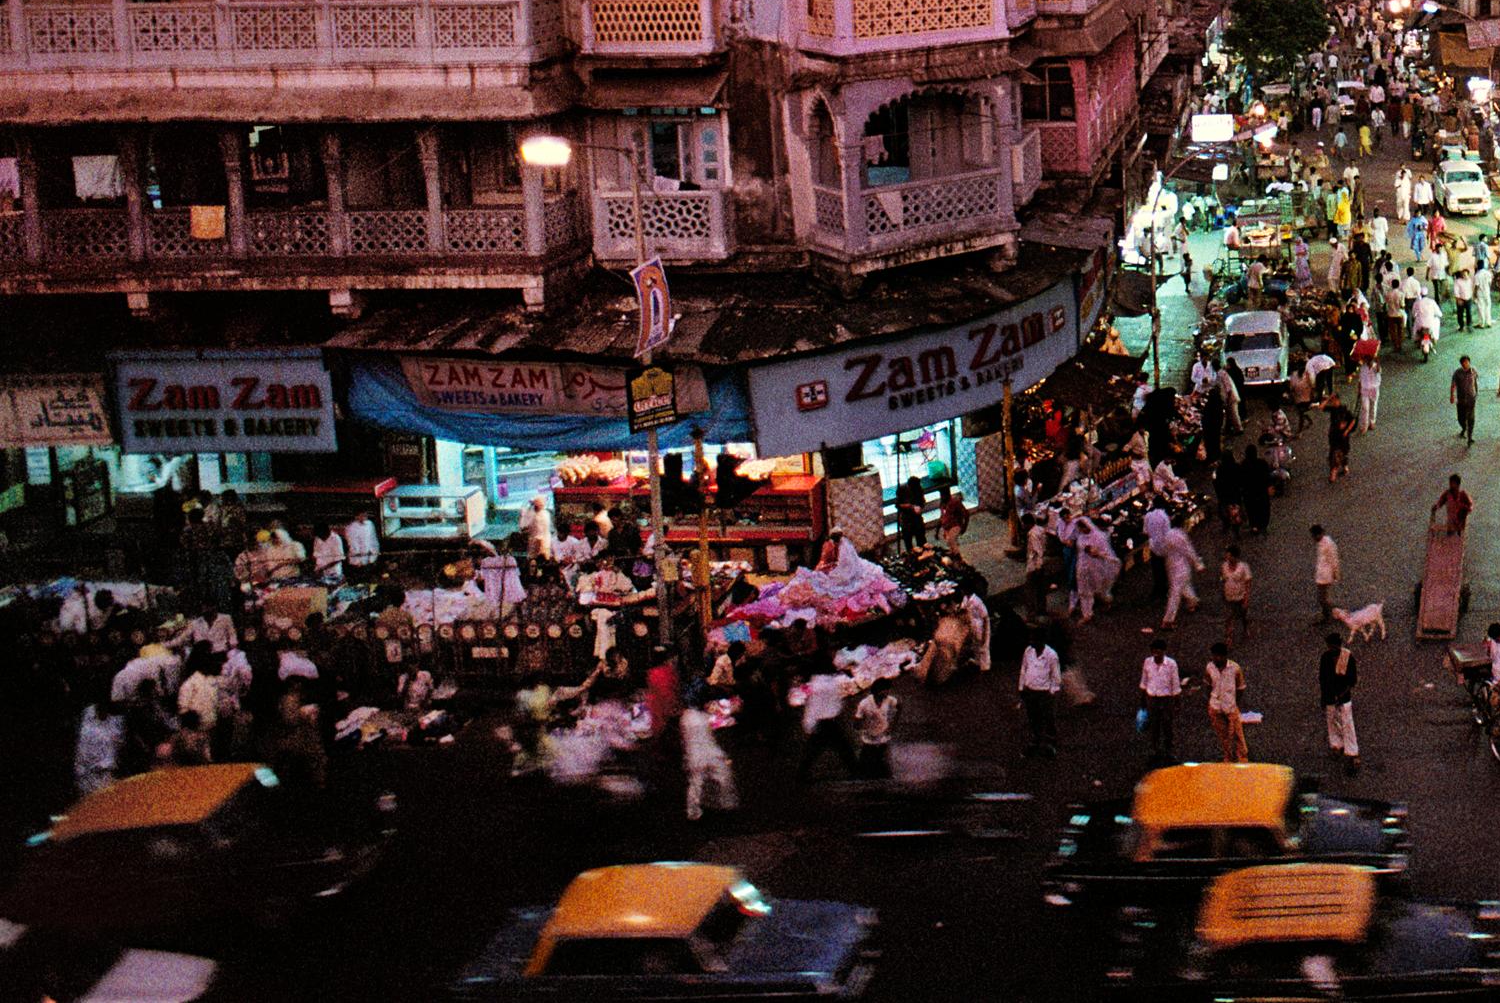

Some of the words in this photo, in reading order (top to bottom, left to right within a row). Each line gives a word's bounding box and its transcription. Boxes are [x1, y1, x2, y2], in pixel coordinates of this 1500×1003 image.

[844, 345, 958, 403] Zam
[968, 312, 1046, 372] Zam
[424, 364, 484, 389] ZAM
[487, 367, 550, 390] ZAM
[888, 379, 956, 411] SWEETS
[960, 375, 973, 390] &
[976, 355, 1025, 387] BAKERY
[127, 377, 220, 411] Zam
[230, 377, 323, 410] Zam
[432, 390, 487, 407] SWEETS
[488, 393, 499, 406] &
[500, 392, 545, 408] BAKERY
[134, 416, 217, 438] SWEETS
[243, 416, 322, 437] BAKERY
